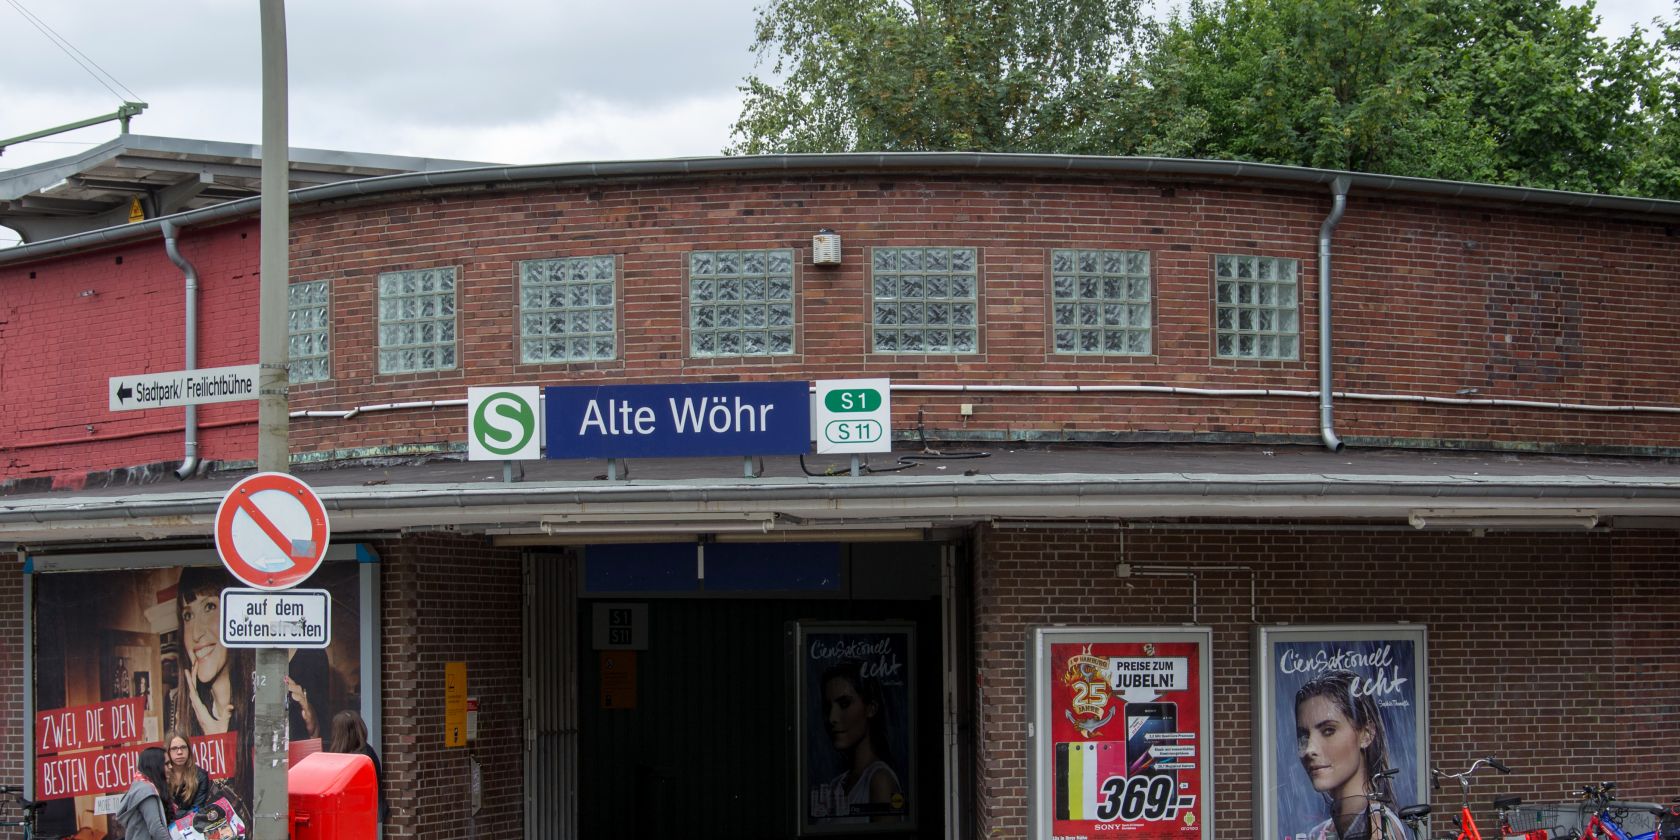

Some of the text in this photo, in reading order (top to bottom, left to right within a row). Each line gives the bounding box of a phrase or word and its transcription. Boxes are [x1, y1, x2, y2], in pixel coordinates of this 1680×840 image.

[136, 374, 252, 405] Stadtpark/ Freilichtbühne
[579, 396, 774, 435] Alte Wöhr
[246, 598, 304, 616] auf dem
[1115, 674, 1174, 688] JUBELN!
[1116, 661, 1174, 671] PREISE ZUM
[1350, 665, 1408, 698] echt
[1072, 681, 1108, 707] 25
[43, 703, 137, 750] ZWEI, DIE DEN
[192, 739, 227, 775] ABEN
[43, 757, 88, 796] BESTEN
